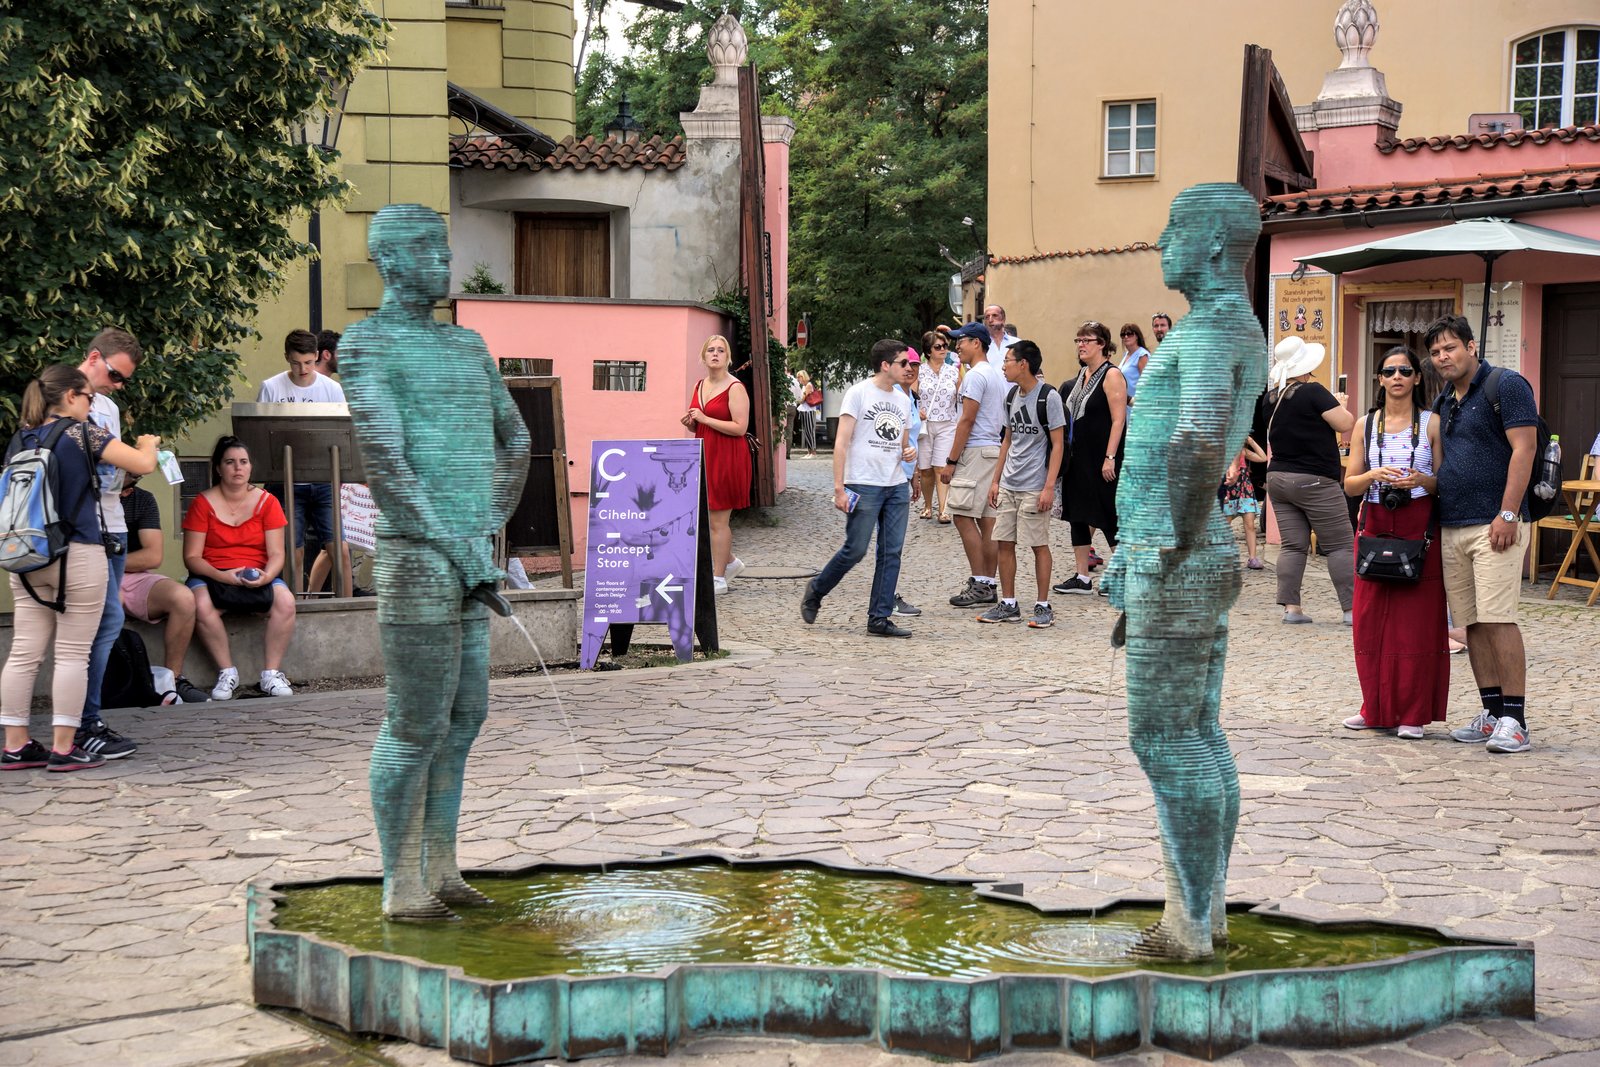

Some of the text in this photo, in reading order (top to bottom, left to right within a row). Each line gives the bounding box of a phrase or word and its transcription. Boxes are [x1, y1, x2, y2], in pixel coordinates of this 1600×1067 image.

[598, 448, 626, 481] C
[599, 509, 646, 519] Cihelna
[597, 544, 650, 556] Concept
[597, 557, 630, 567] Store
